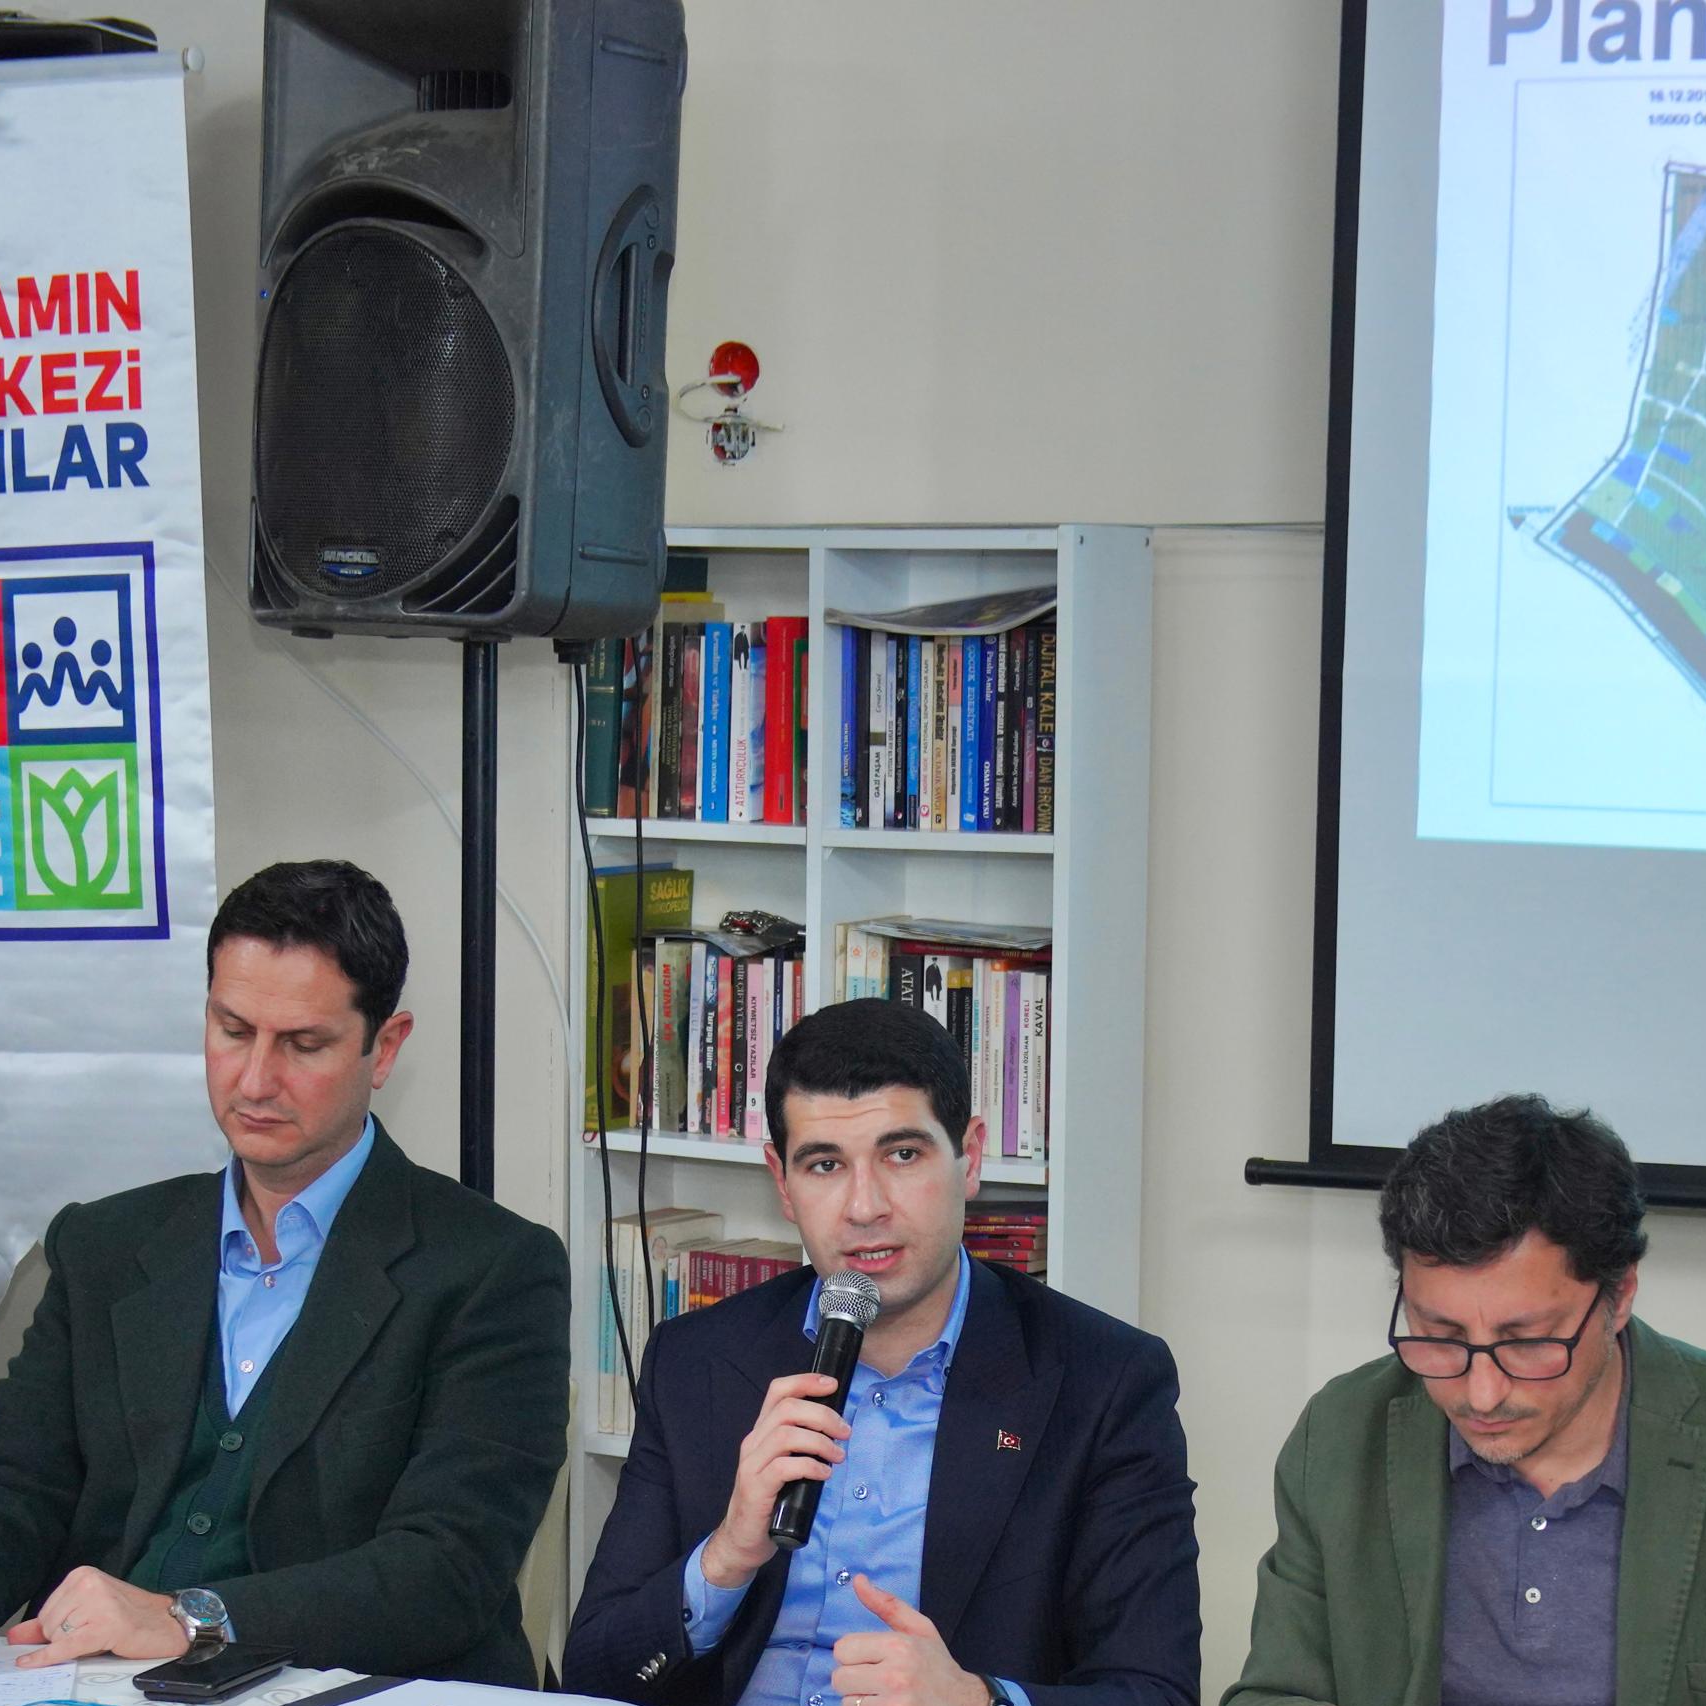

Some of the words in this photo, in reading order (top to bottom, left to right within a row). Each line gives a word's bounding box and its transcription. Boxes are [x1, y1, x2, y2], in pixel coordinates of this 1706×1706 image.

[1039, 692, 1054, 733] KALE
[874, 752, 883, 778] PAŞAM
[983, 761, 991, 795] OSMAN
[1038, 757, 1053, 784] DAN
[873, 780, 882, 798] GAZİ
[1036, 786, 1053, 832] BROWN
[650, 877, 690, 901] SAĞLIK
[735, 964, 745, 981] BİR
[900, 967, 914, 1005] ATAT
[705, 1011, 715, 1043] Turgay
[735, 1006, 745, 1040] YÜREK
[749, 996, 758, 1041] KIYMETSİZ
[1023, 999, 1031, 1029] KORELİ
[1034, 997, 1044, 1037] KAVAL
[706, 1046, 715, 1071] Güler
[749, 1044, 757, 1079] YAZILAR
[1022, 1035, 1031, 1064] ÖZİLHAN
[1022, 1065, 1030, 1105] BEYTULLAH
